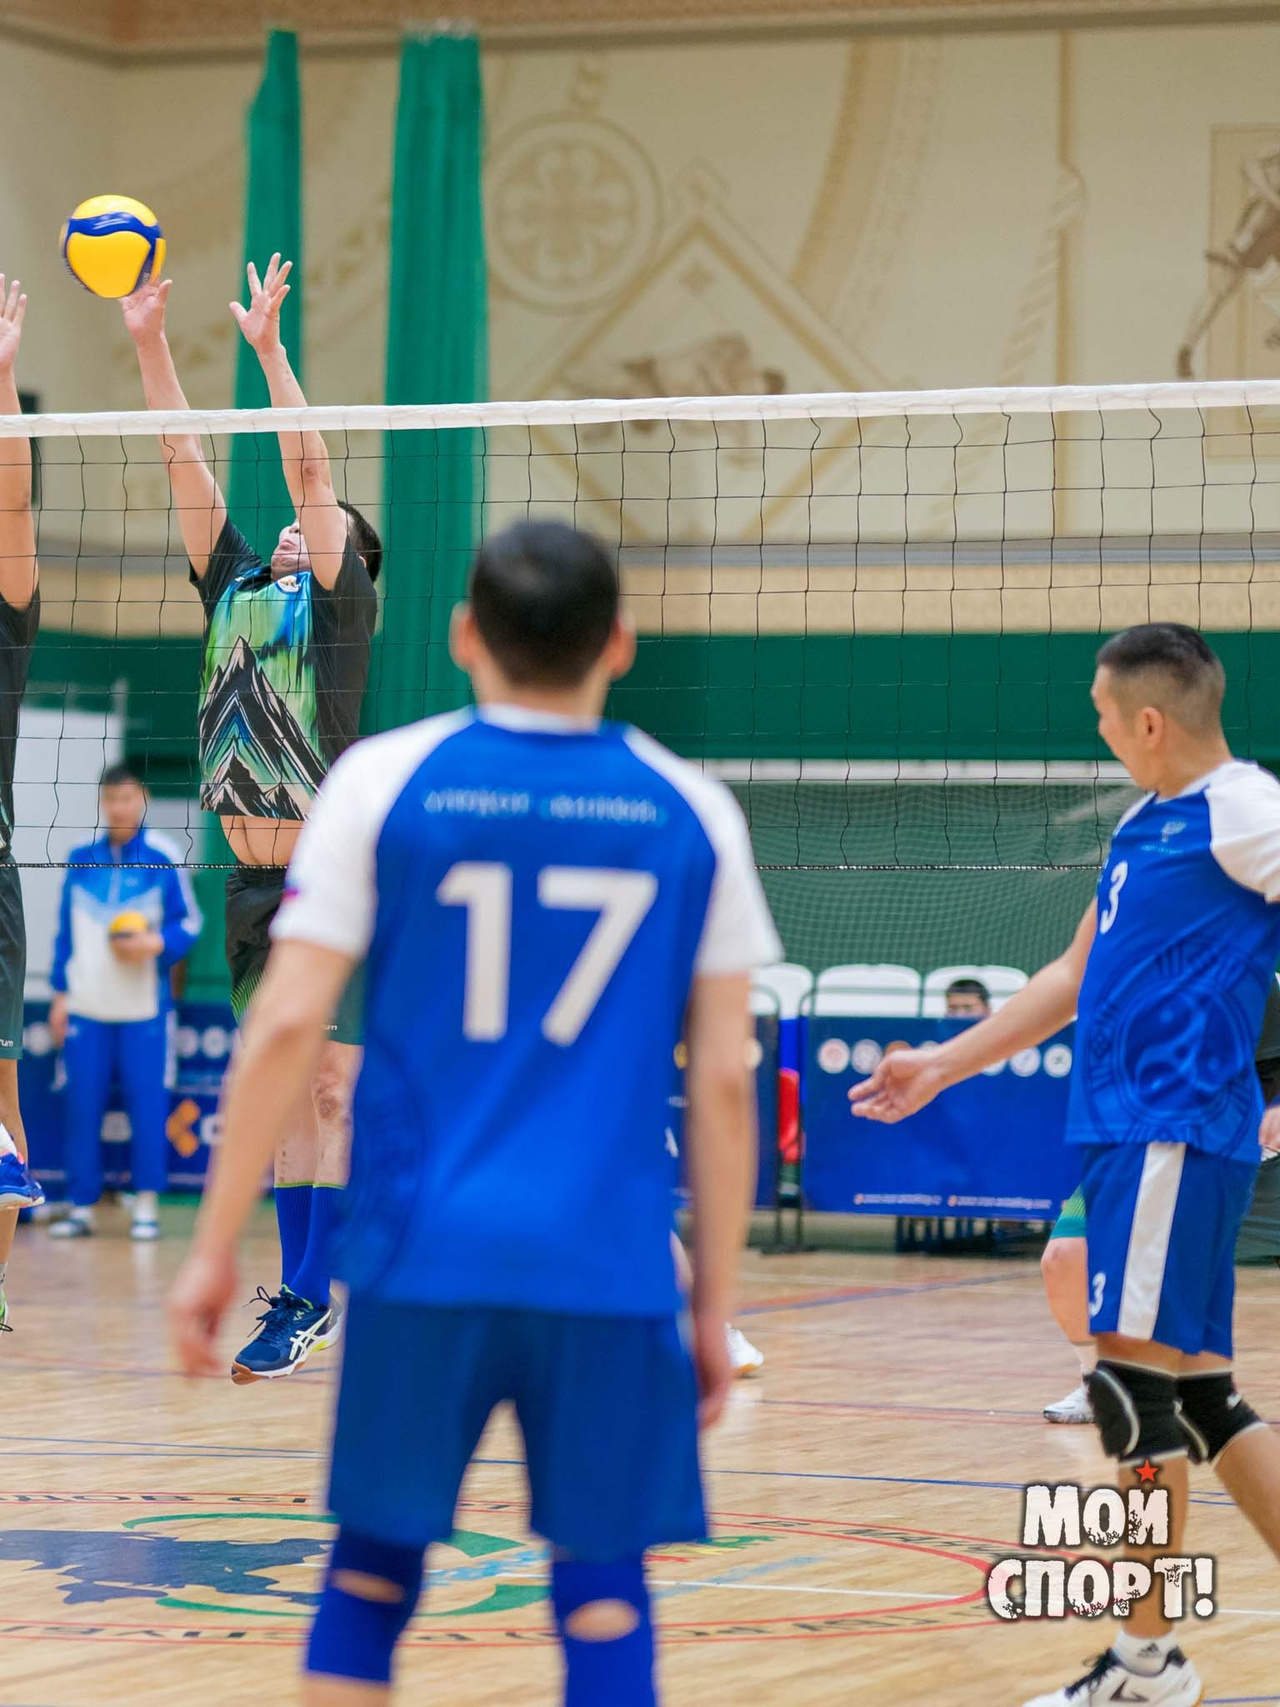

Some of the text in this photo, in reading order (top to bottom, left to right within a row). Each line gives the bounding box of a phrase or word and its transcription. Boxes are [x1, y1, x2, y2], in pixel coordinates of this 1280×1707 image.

[1100, 860, 1128, 935] 3
[436, 861, 658, 1047] 17
[1090, 1272, 1107, 1317] 3
